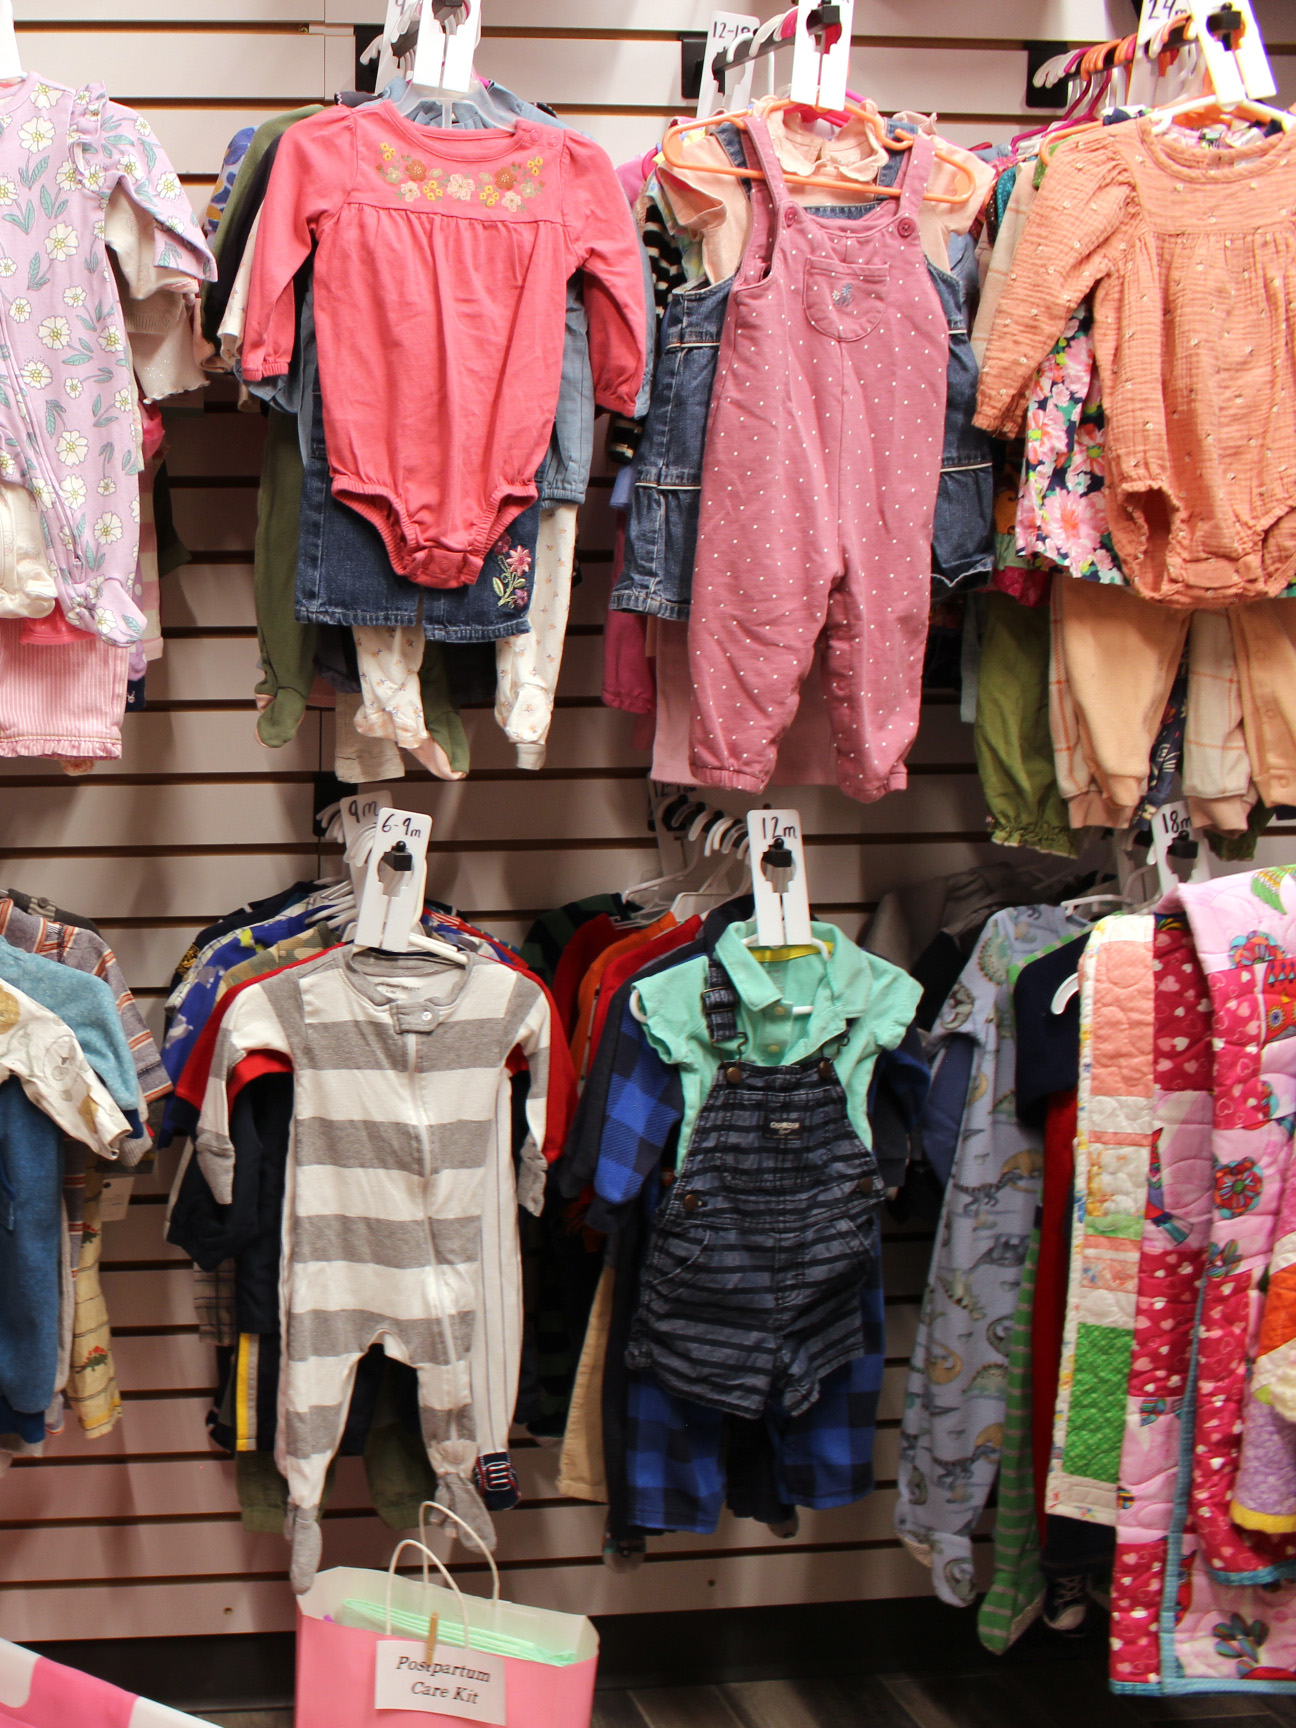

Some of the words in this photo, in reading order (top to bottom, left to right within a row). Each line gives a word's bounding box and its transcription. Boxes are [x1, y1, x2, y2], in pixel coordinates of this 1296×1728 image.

[381, 813, 422, 838] 6-9m
[762, 816, 798, 840] 12m
[395, 1655, 491, 1683] Postpartum
[410, 1680, 450, 1699] Care
[451, 1685, 480, 1705] Kit
